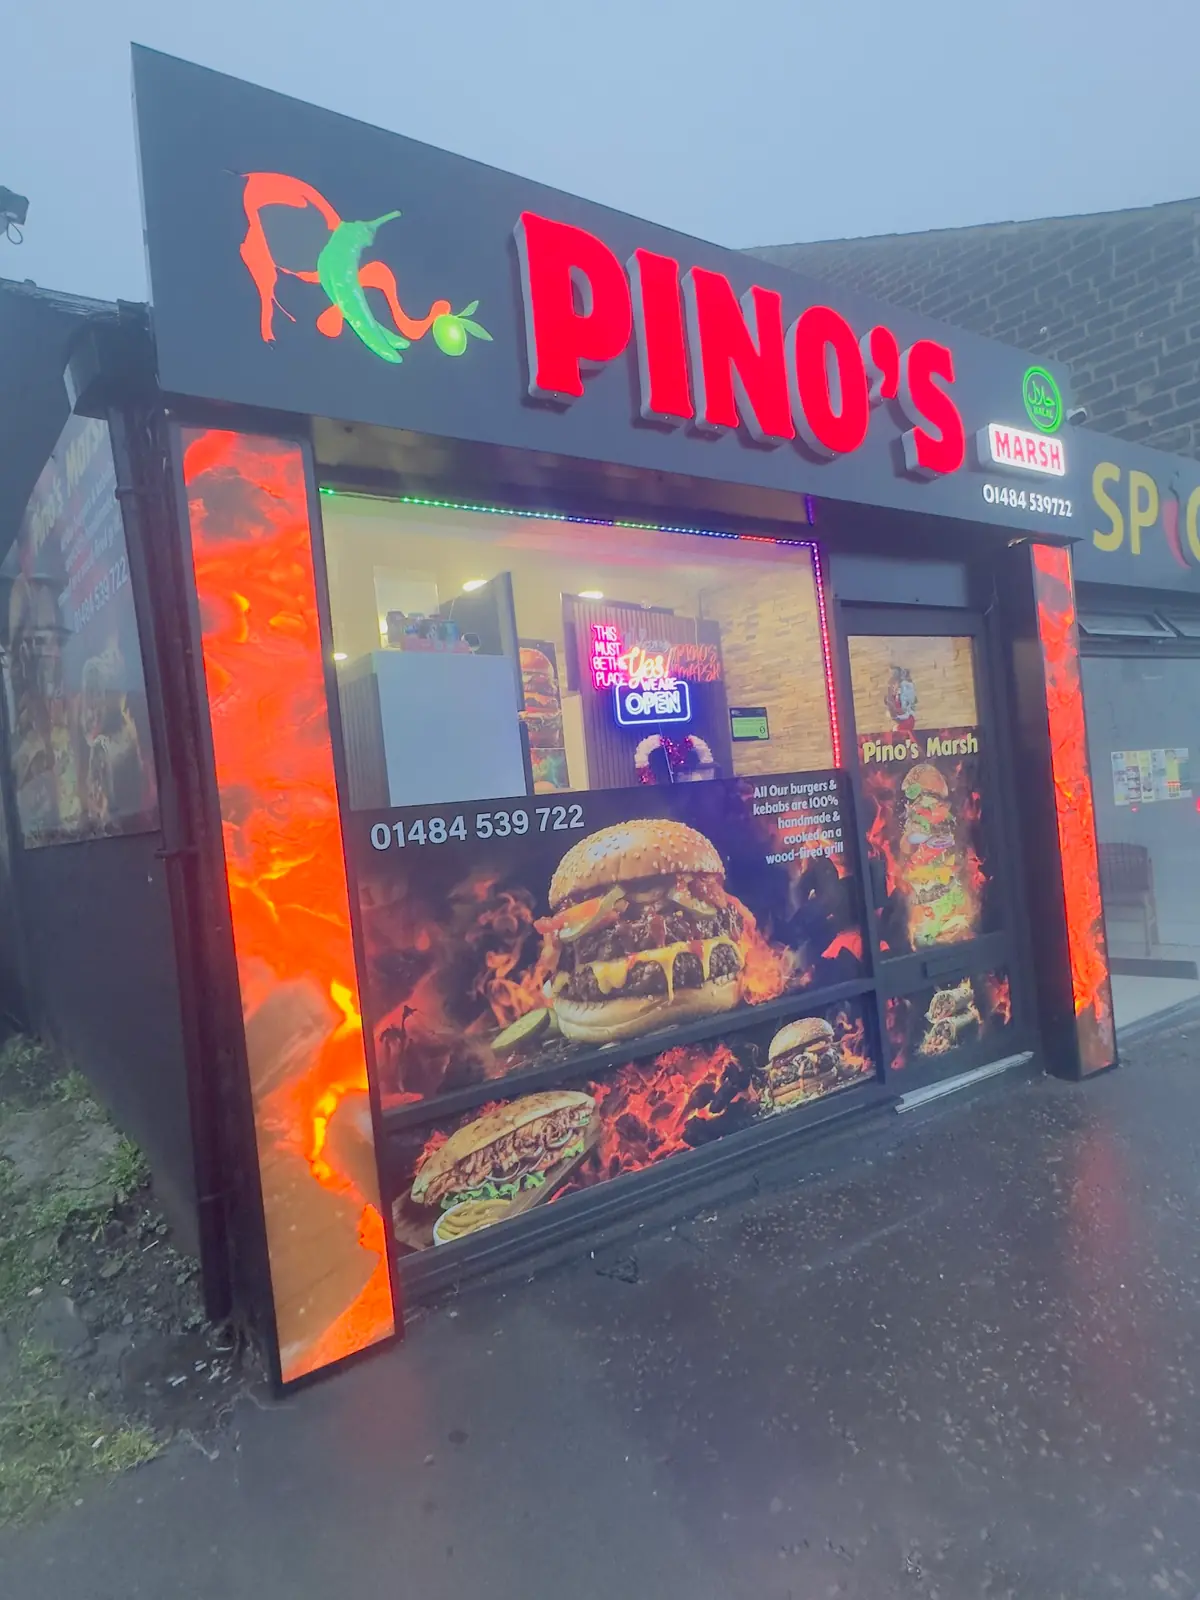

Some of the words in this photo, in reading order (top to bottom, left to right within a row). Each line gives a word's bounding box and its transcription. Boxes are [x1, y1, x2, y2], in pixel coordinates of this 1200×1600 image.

[514, 211, 965, 476] PINO'S
[994, 430, 1062, 470] MARSH
[983, 483, 1027, 509] 01484
[1029, 492, 1073, 517] 539722
[594, 624, 618, 642] THIS
[595, 641, 622, 656] MUST
[596, 671, 628, 687] PLACE
[625, 691, 682, 715] OPEN
[863, 739, 919, 764] Pino's
[926, 733, 978, 757] Marsh
[753, 786, 767, 799] All
[769, 785, 788, 796] Our
[790, 782, 827, 796] burgers
[829, 779, 837, 790] &
[753, 801, 790, 816] kebabs
[791, 801, 808, 811] are
[809, 795, 839, 809] 100%
[370, 816, 468, 850] 01484
[475, 809, 530, 839] 539
[535, 804, 585, 831] 722
[777, 811, 831, 829] handmade
[832, 811, 840, 821] &
[783, 829, 820, 844] cooked
[821, 829, 834, 840] on
[835, 828, 842, 838] a
[765, 845, 823, 865] wood-fired
[824, 841, 844, 858] grill
